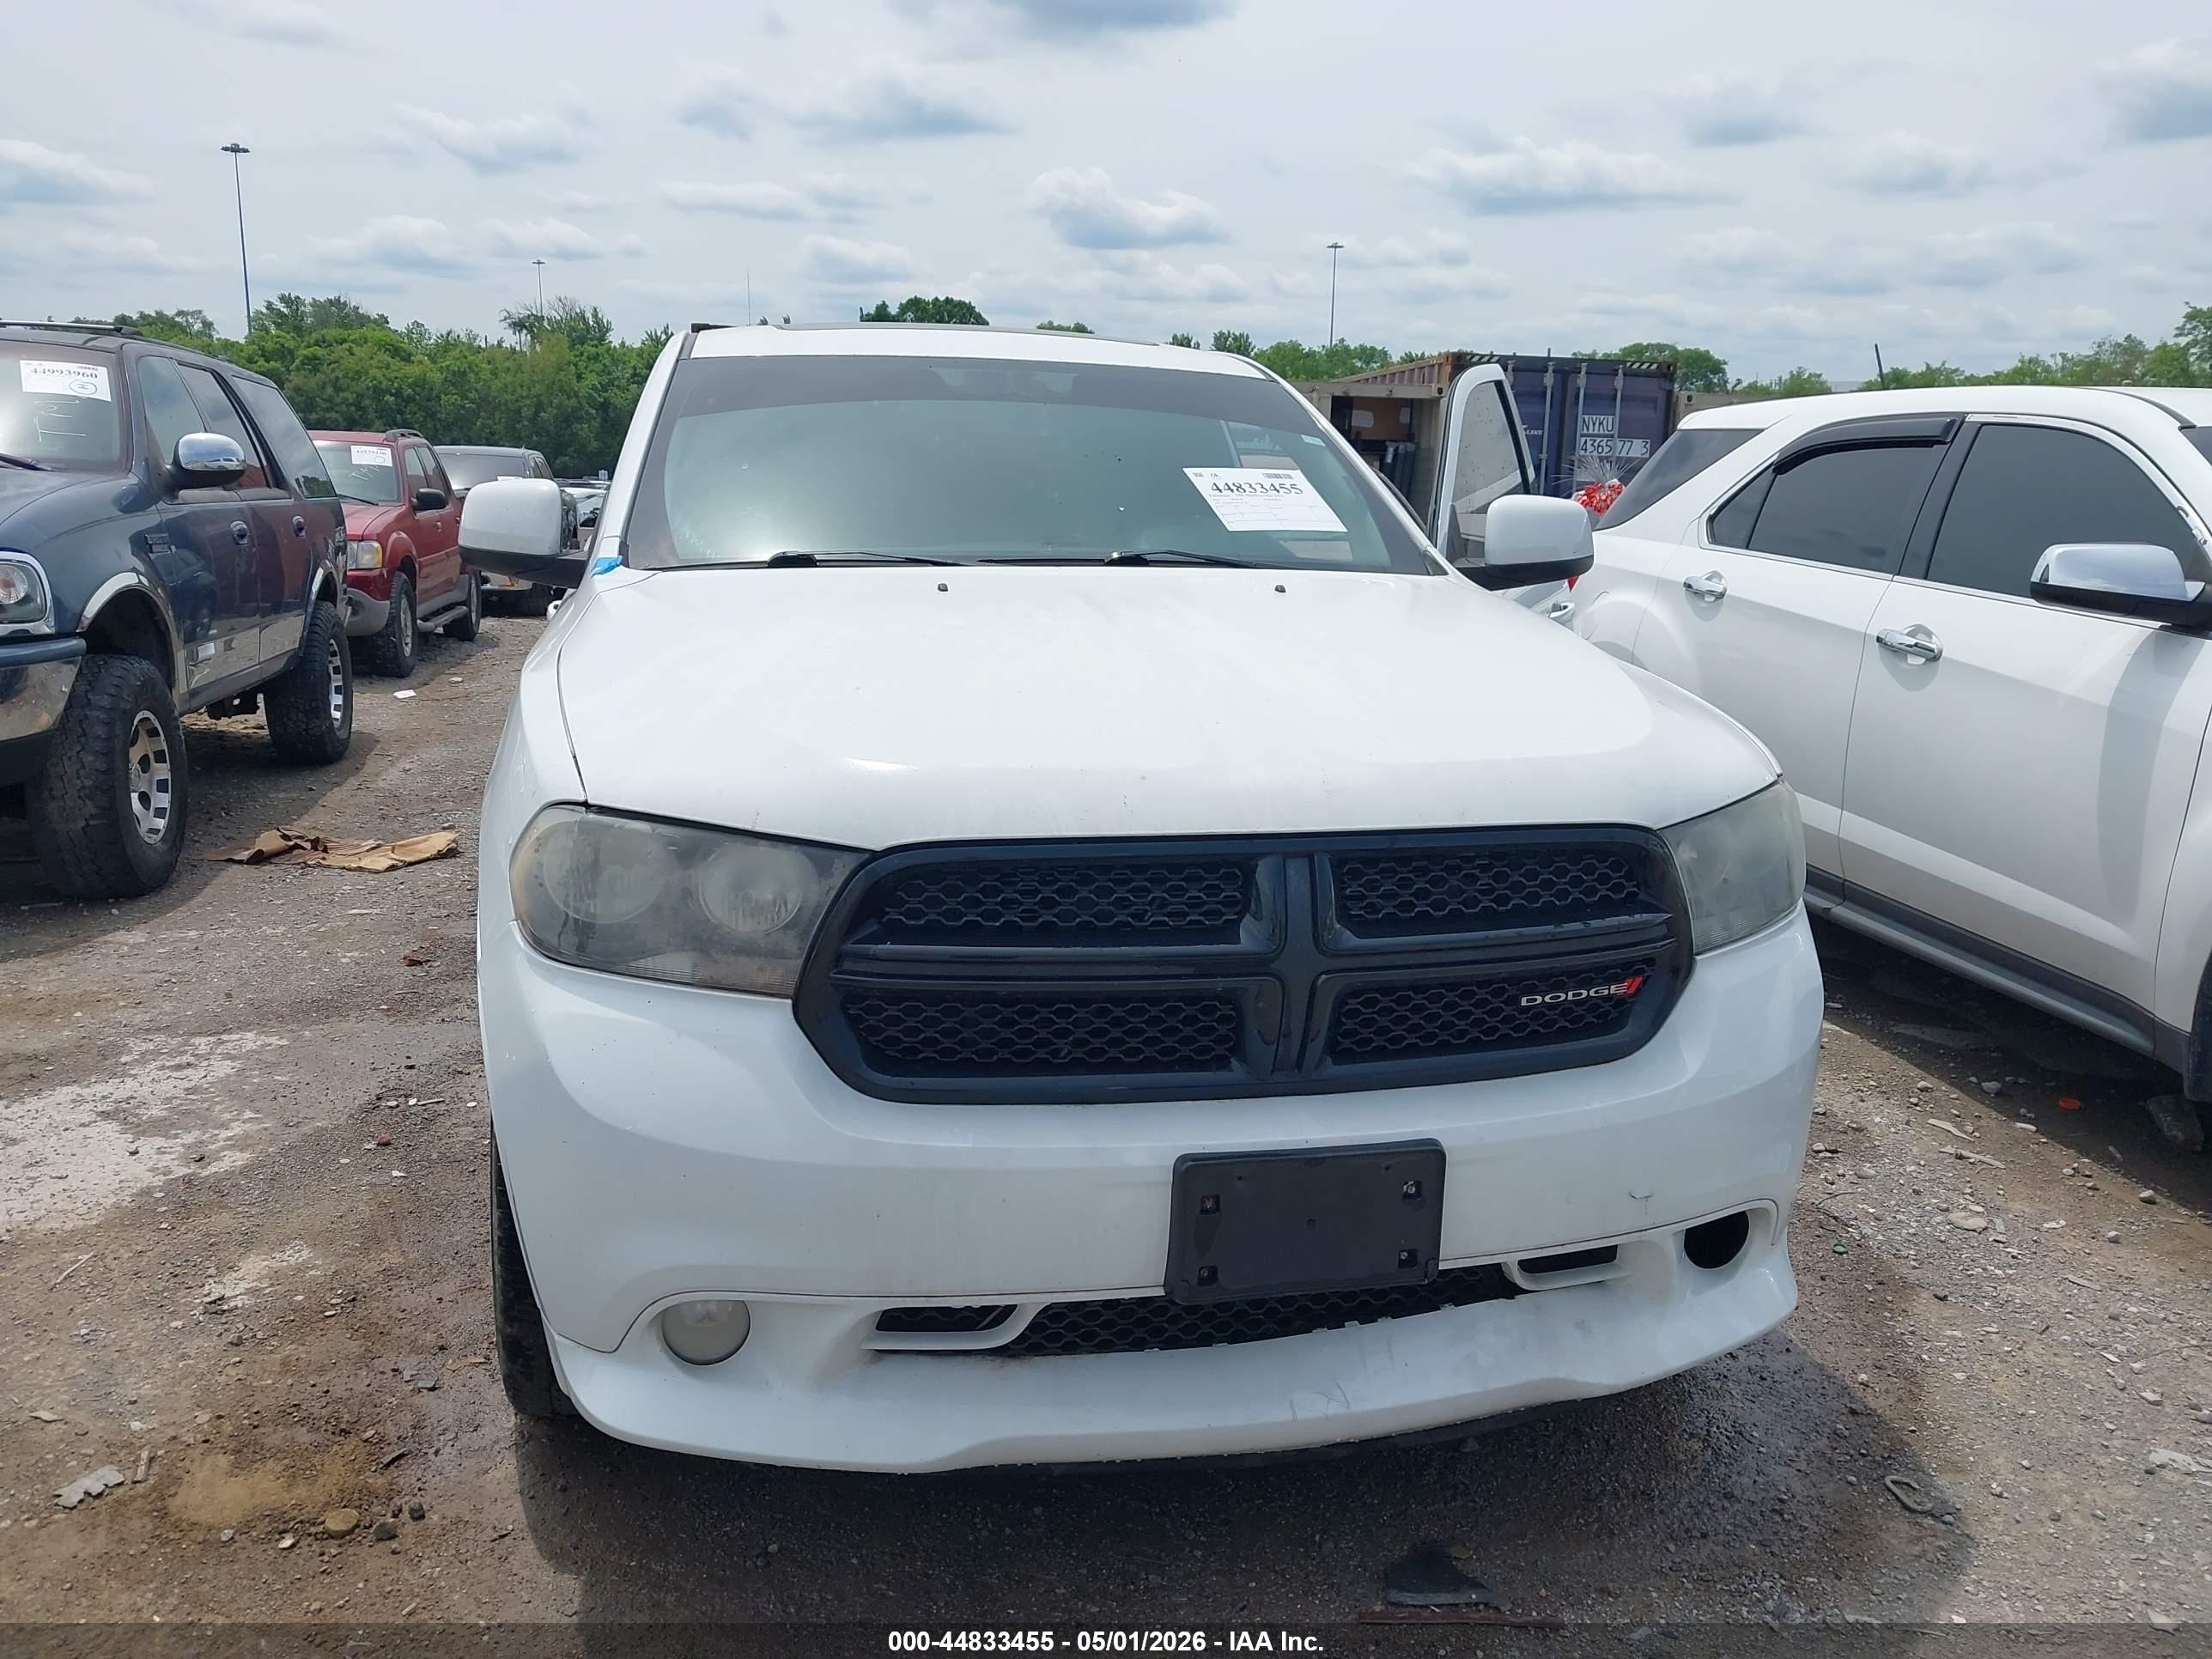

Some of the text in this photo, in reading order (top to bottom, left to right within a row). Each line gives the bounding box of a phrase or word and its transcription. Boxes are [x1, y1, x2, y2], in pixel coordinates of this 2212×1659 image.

[1582, 416, 1614, 433] NYKU
[1641, 441, 1649, 456] 3
[1211, 482, 1303, 495] 44833455
[1521, 982, 1628, 1006] DODGE
